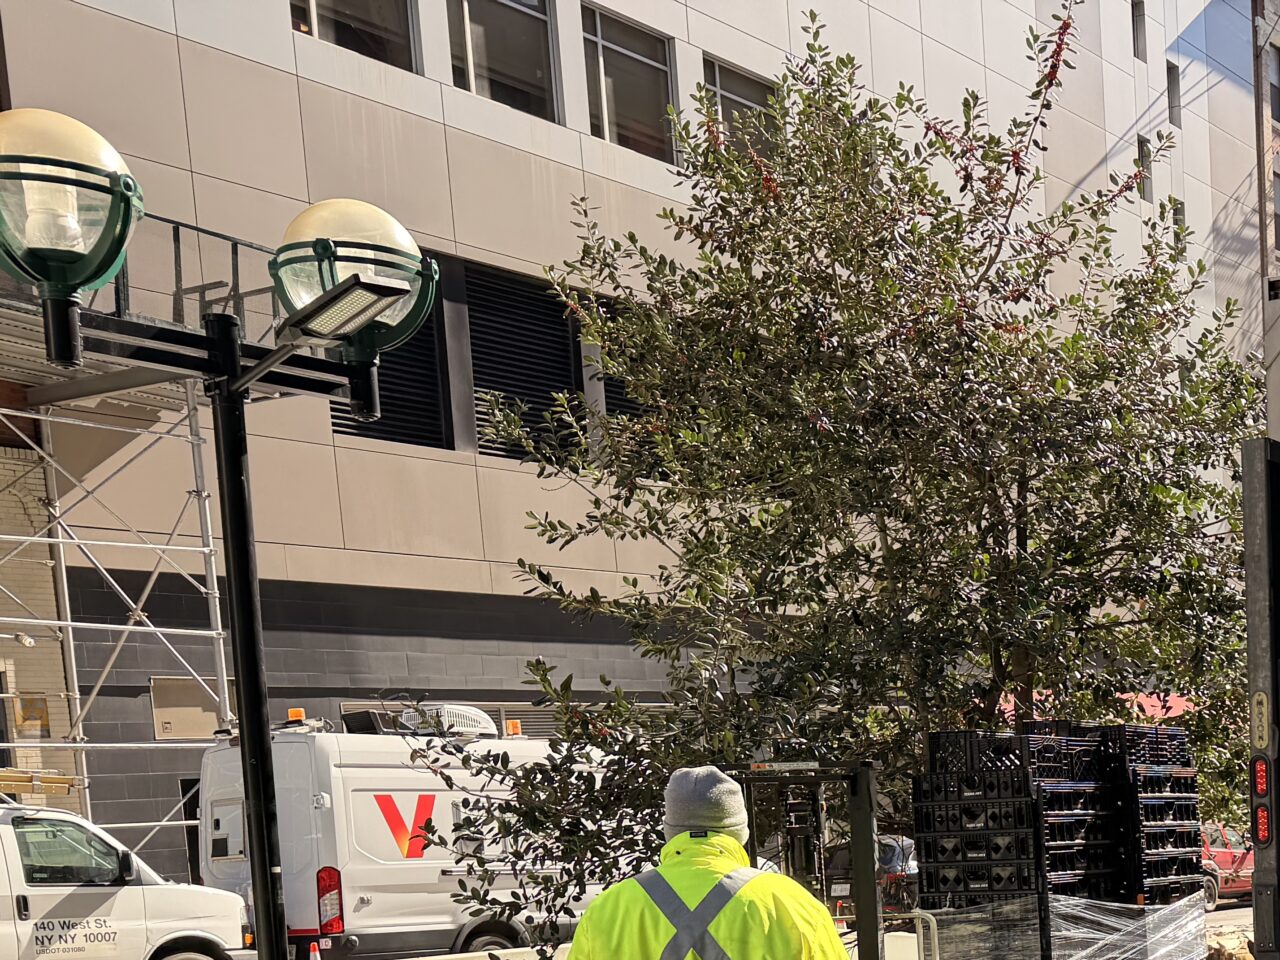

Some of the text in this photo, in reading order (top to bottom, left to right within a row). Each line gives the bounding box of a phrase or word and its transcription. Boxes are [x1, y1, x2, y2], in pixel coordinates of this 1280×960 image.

[1255, 697, 1265, 742] MAXON
[373, 794, 436, 859] V
[34, 918, 112, 932] 140 West St.
[34, 931, 118, 946] NY NY 10007
